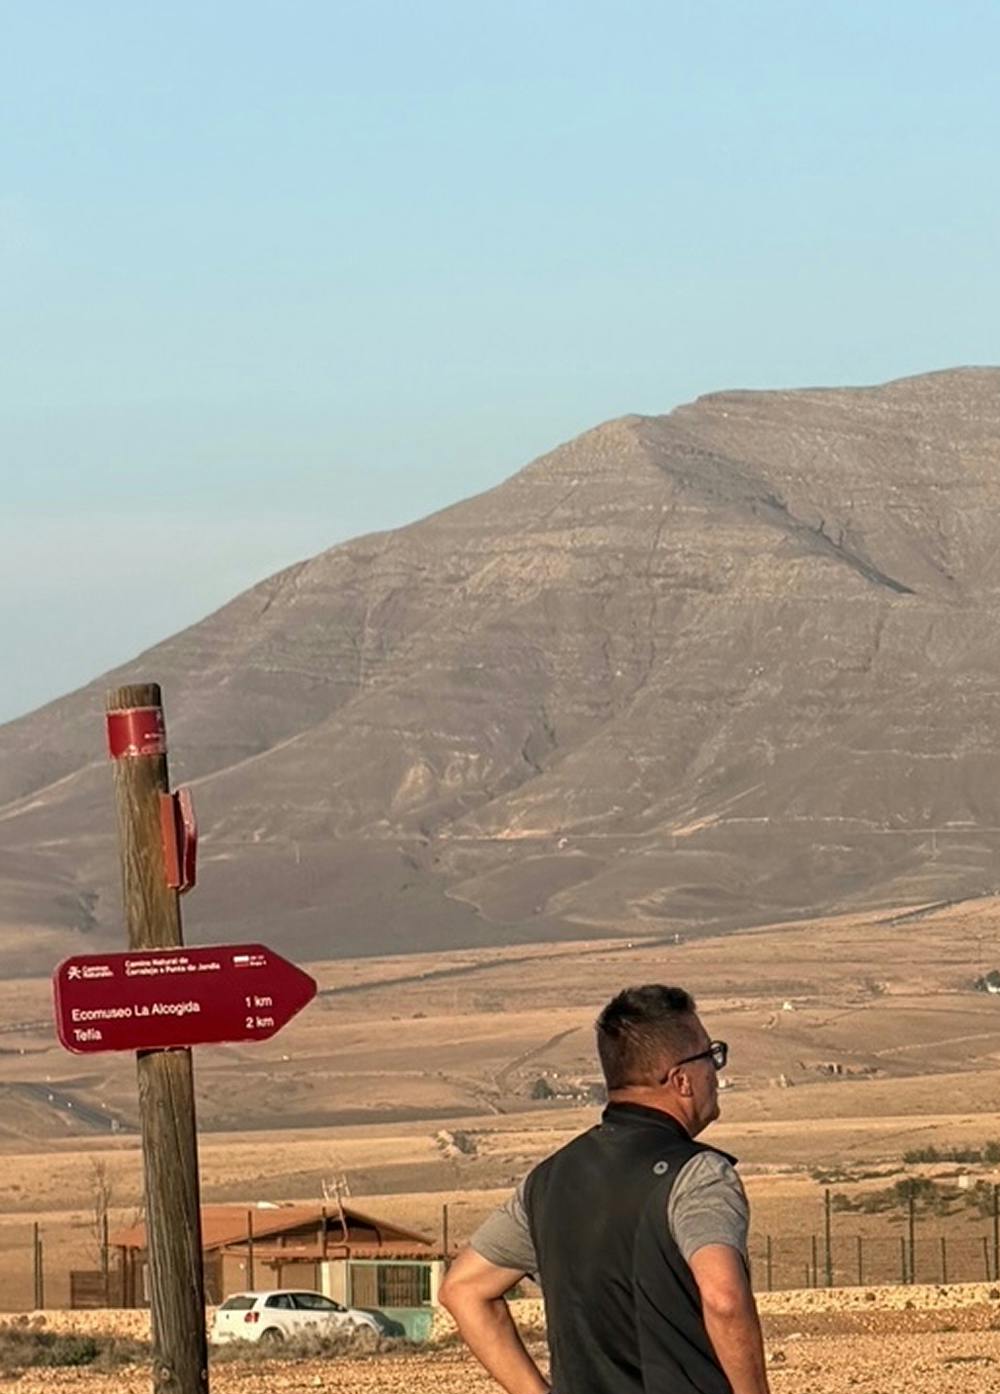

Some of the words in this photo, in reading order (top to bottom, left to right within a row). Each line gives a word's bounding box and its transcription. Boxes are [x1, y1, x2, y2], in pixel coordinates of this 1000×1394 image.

[72, 1007, 132, 1021] Ecomuseo
[134, 1004, 150, 1016] La
[152, 1001, 200, 1017] Alcogida
[245, 996, 251, 1008] 1
[254, 995, 273, 1007] km
[245, 1016, 254, 1029] 2
[255, 1016, 275, 1028] km
